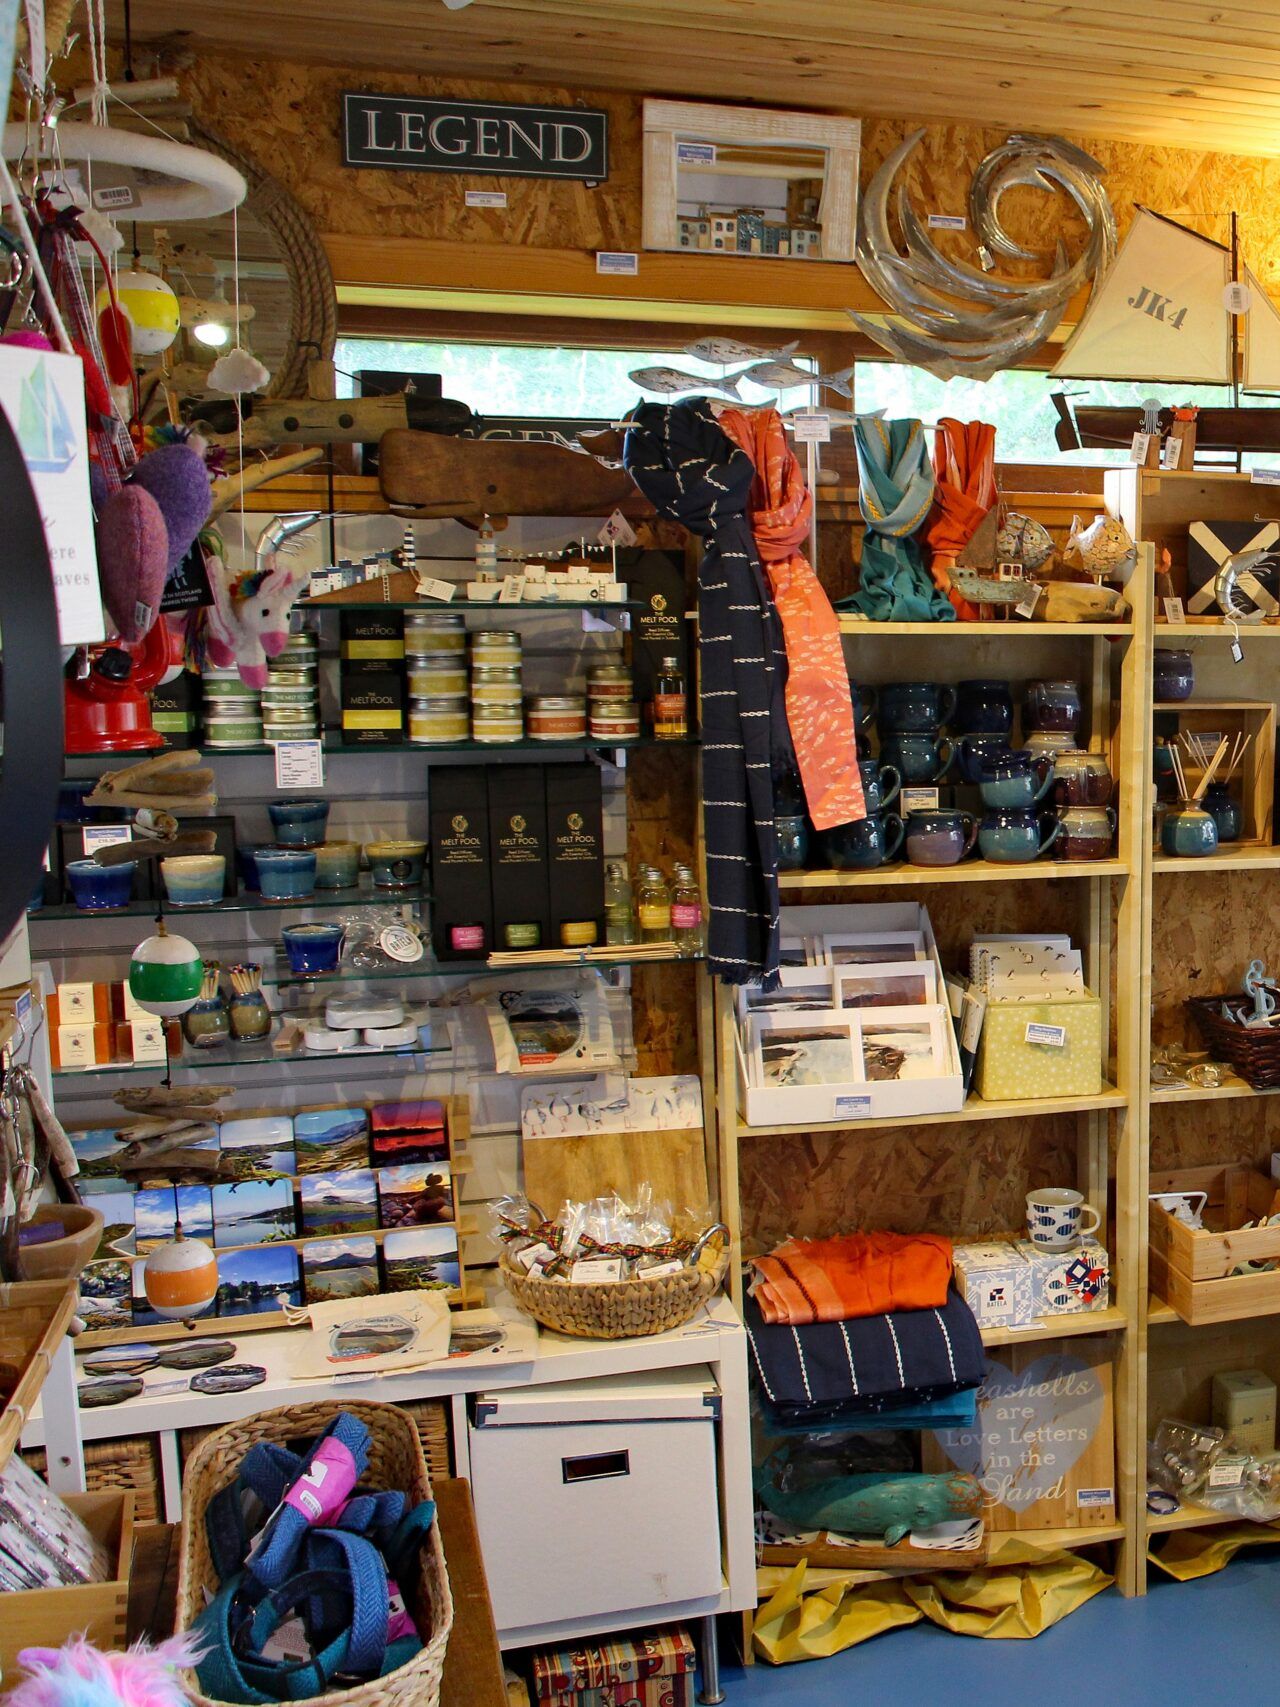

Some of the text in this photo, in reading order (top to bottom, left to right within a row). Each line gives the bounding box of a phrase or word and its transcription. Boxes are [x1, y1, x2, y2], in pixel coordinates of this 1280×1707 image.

[361, 109, 592, 162] LEGEND
[1127, 286, 1188, 330] JK4
[152, 700, 178, 708] POOL
[976, 1371, 1096, 1400] eashells
[996, 1406, 1034, 1420] are
[946, 1427, 1088, 1446] Love Letters
[989, 1450, 1056, 1468] in the
[980, 1471, 1068, 1508] Sand
